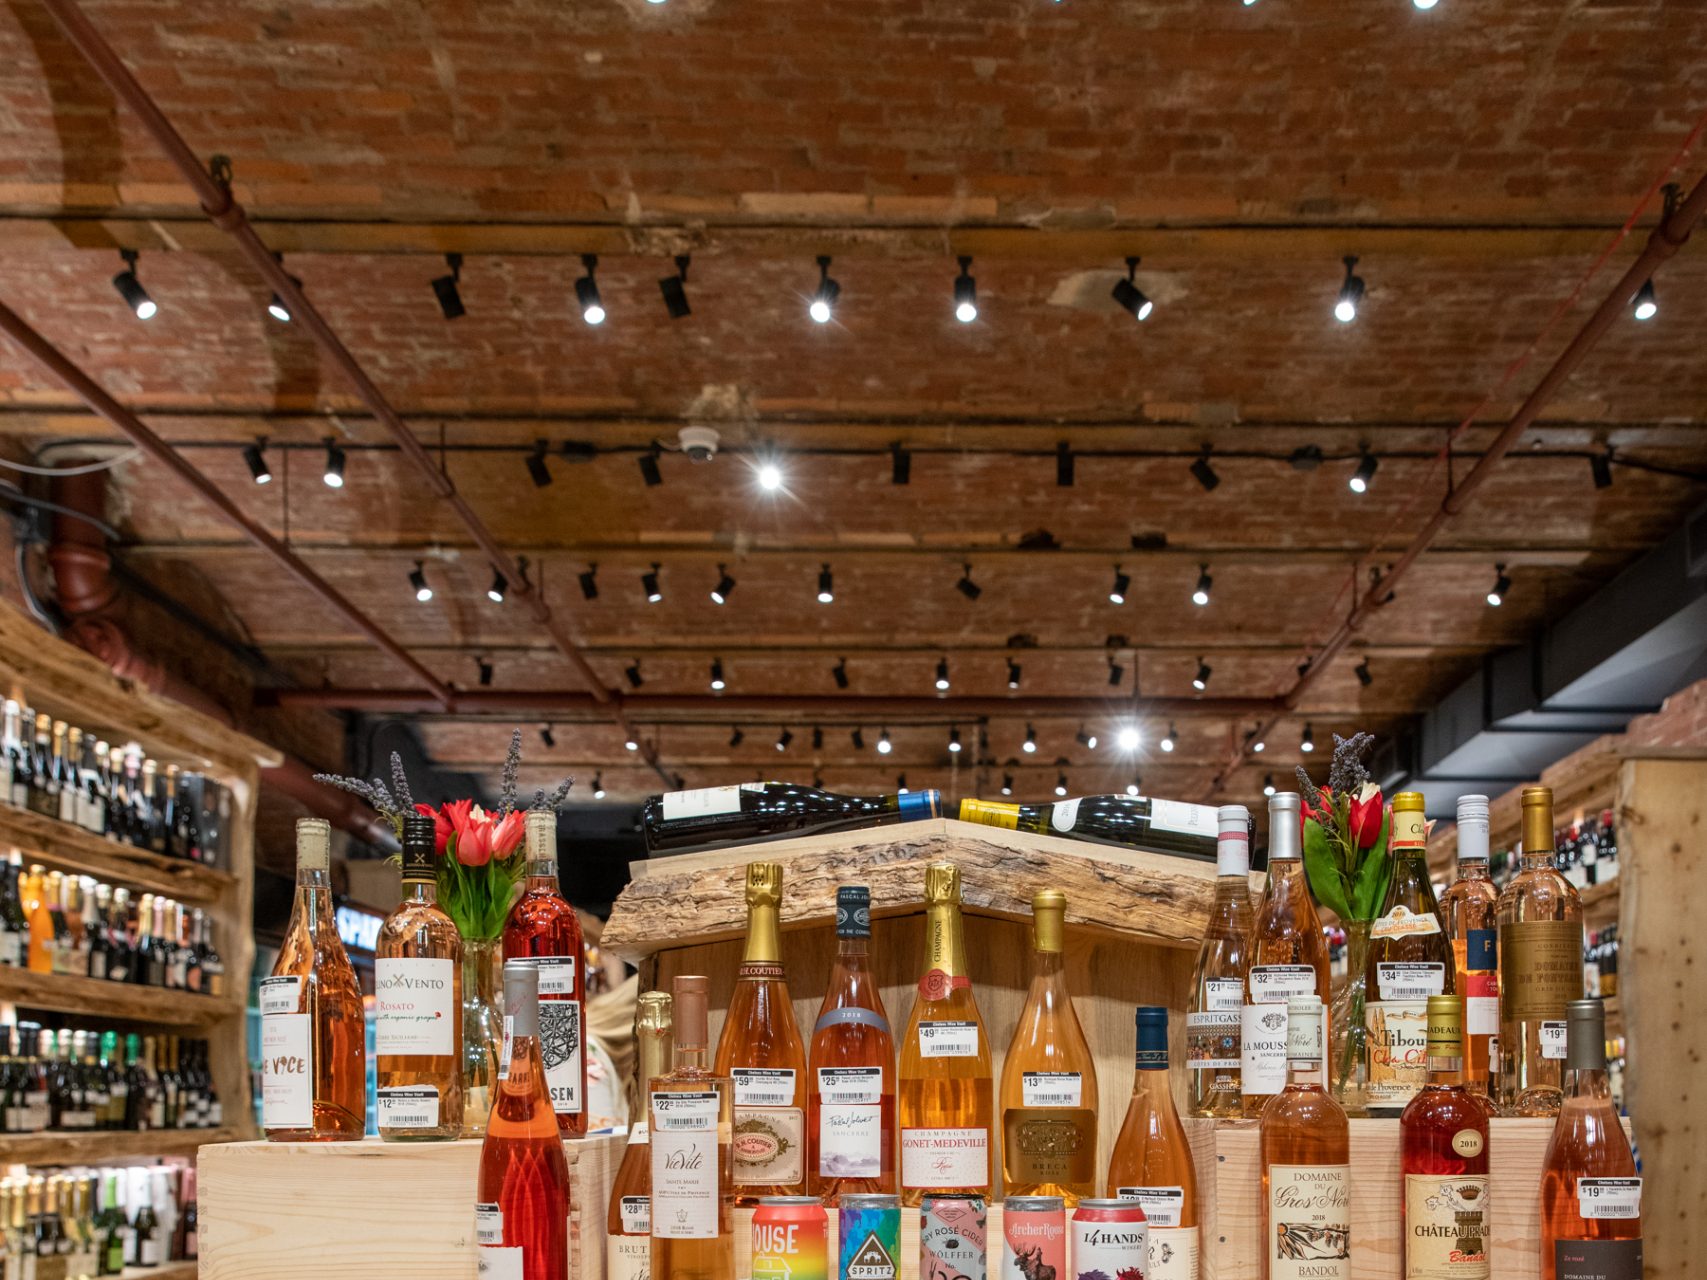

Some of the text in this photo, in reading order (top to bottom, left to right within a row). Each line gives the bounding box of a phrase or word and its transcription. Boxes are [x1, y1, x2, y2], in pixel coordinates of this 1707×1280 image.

[1484, 939, 1492, 952] F
[405, 978, 444, 990] VENTO
[380, 1001, 415, 1012] ROSATO
[1546, 1030, 1560, 1038] $19
[1244, 1042, 1251, 1050] LA
[823, 1076, 836, 1086] $25
[1024, 1078, 1038, 1086] $13
[550, 1088, 574, 1101] SEN
[656, 1100, 670, 1110] $22
[902, 1138, 986, 1148] GONET-MEDEVILLE
[1460, 1140, 1478, 1148] 2018
[1294, 1172, 1342, 1182] DOMAINE
[1582, 1187, 1599, 1197] $19
[935, 1224, 959, 1236] ROSÉ
[1414, 1223, 1467, 1238] CHÂTEAU
[1084, 1230, 1144, 1246] 14 HANDS
[619, 1244, 647, 1254] BRUT
[930, 1250, 974, 1259] WÖLFFER
[1449, 1250, 1487, 1263] Bandol
[852, 1267, 892, 1275] SPRITZ
[1298, 1265, 1339, 1276] BANDOL
